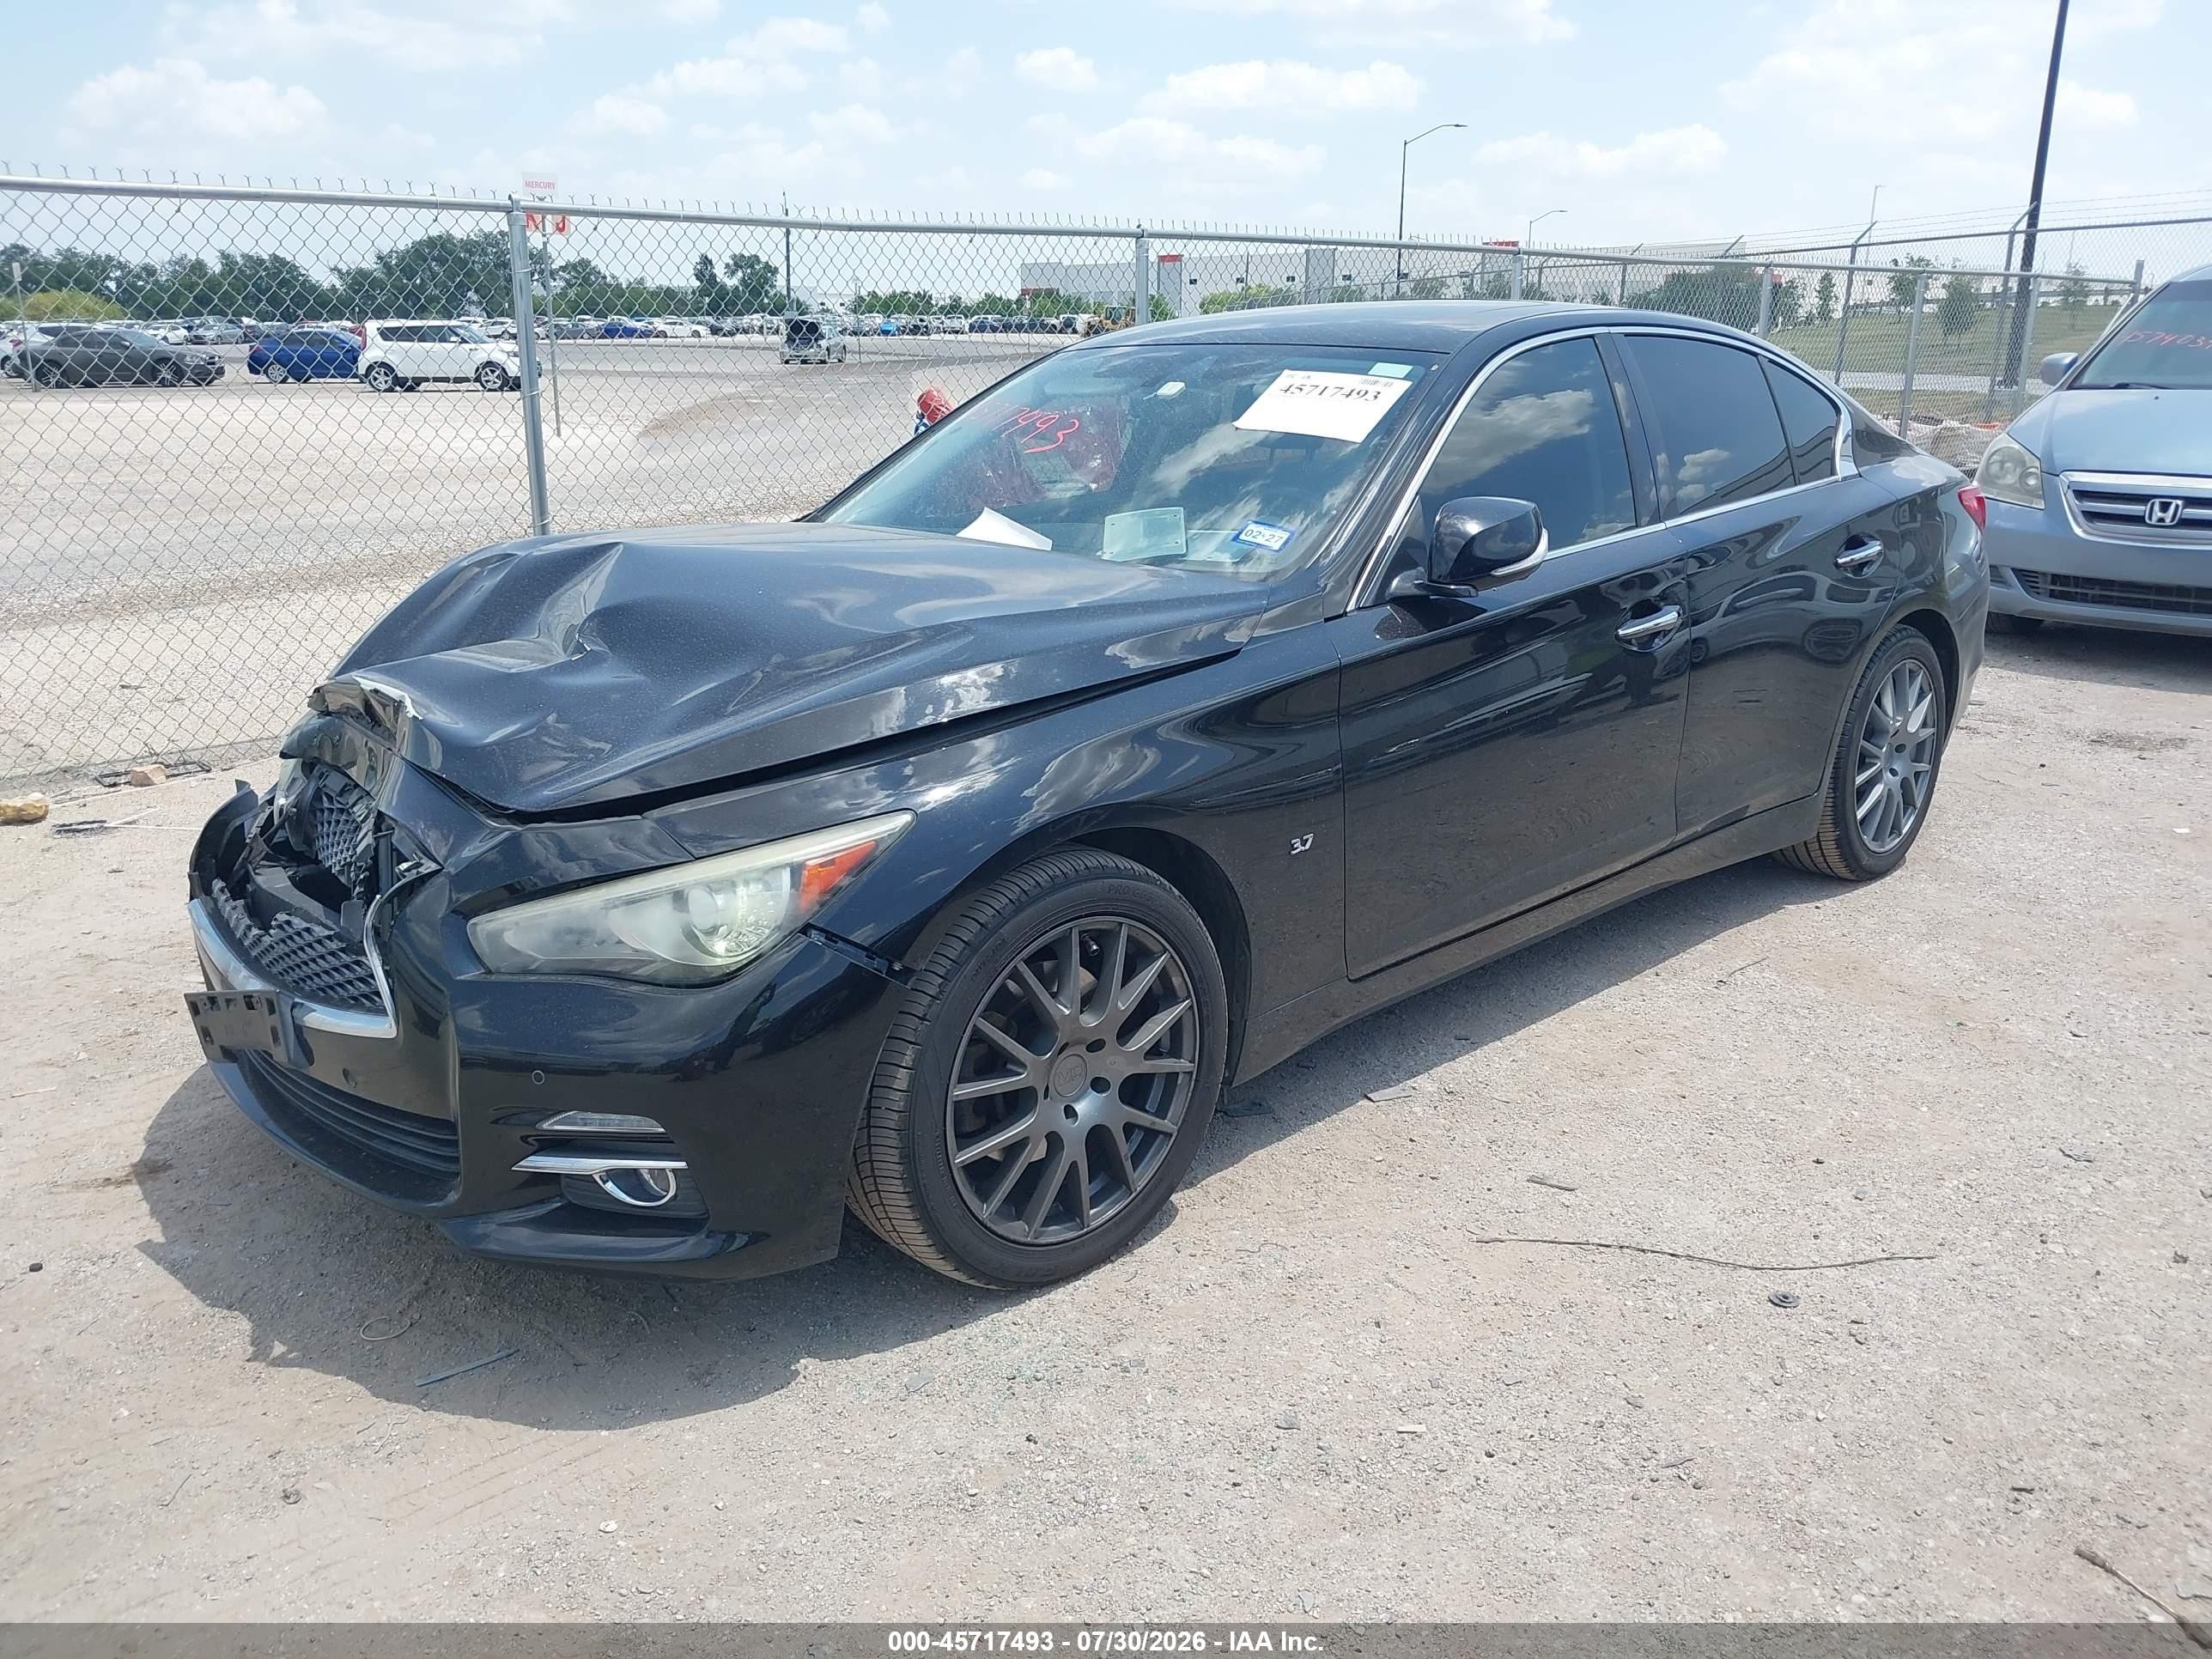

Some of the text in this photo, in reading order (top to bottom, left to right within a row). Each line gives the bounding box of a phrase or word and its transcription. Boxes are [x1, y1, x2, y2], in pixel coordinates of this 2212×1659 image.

[525, 179, 556, 190] MERCURY
[1279, 383, 1382, 402] 45717493
[1243, 529, 1262, 540] 02
[1264, 534, 1284, 544] 27
